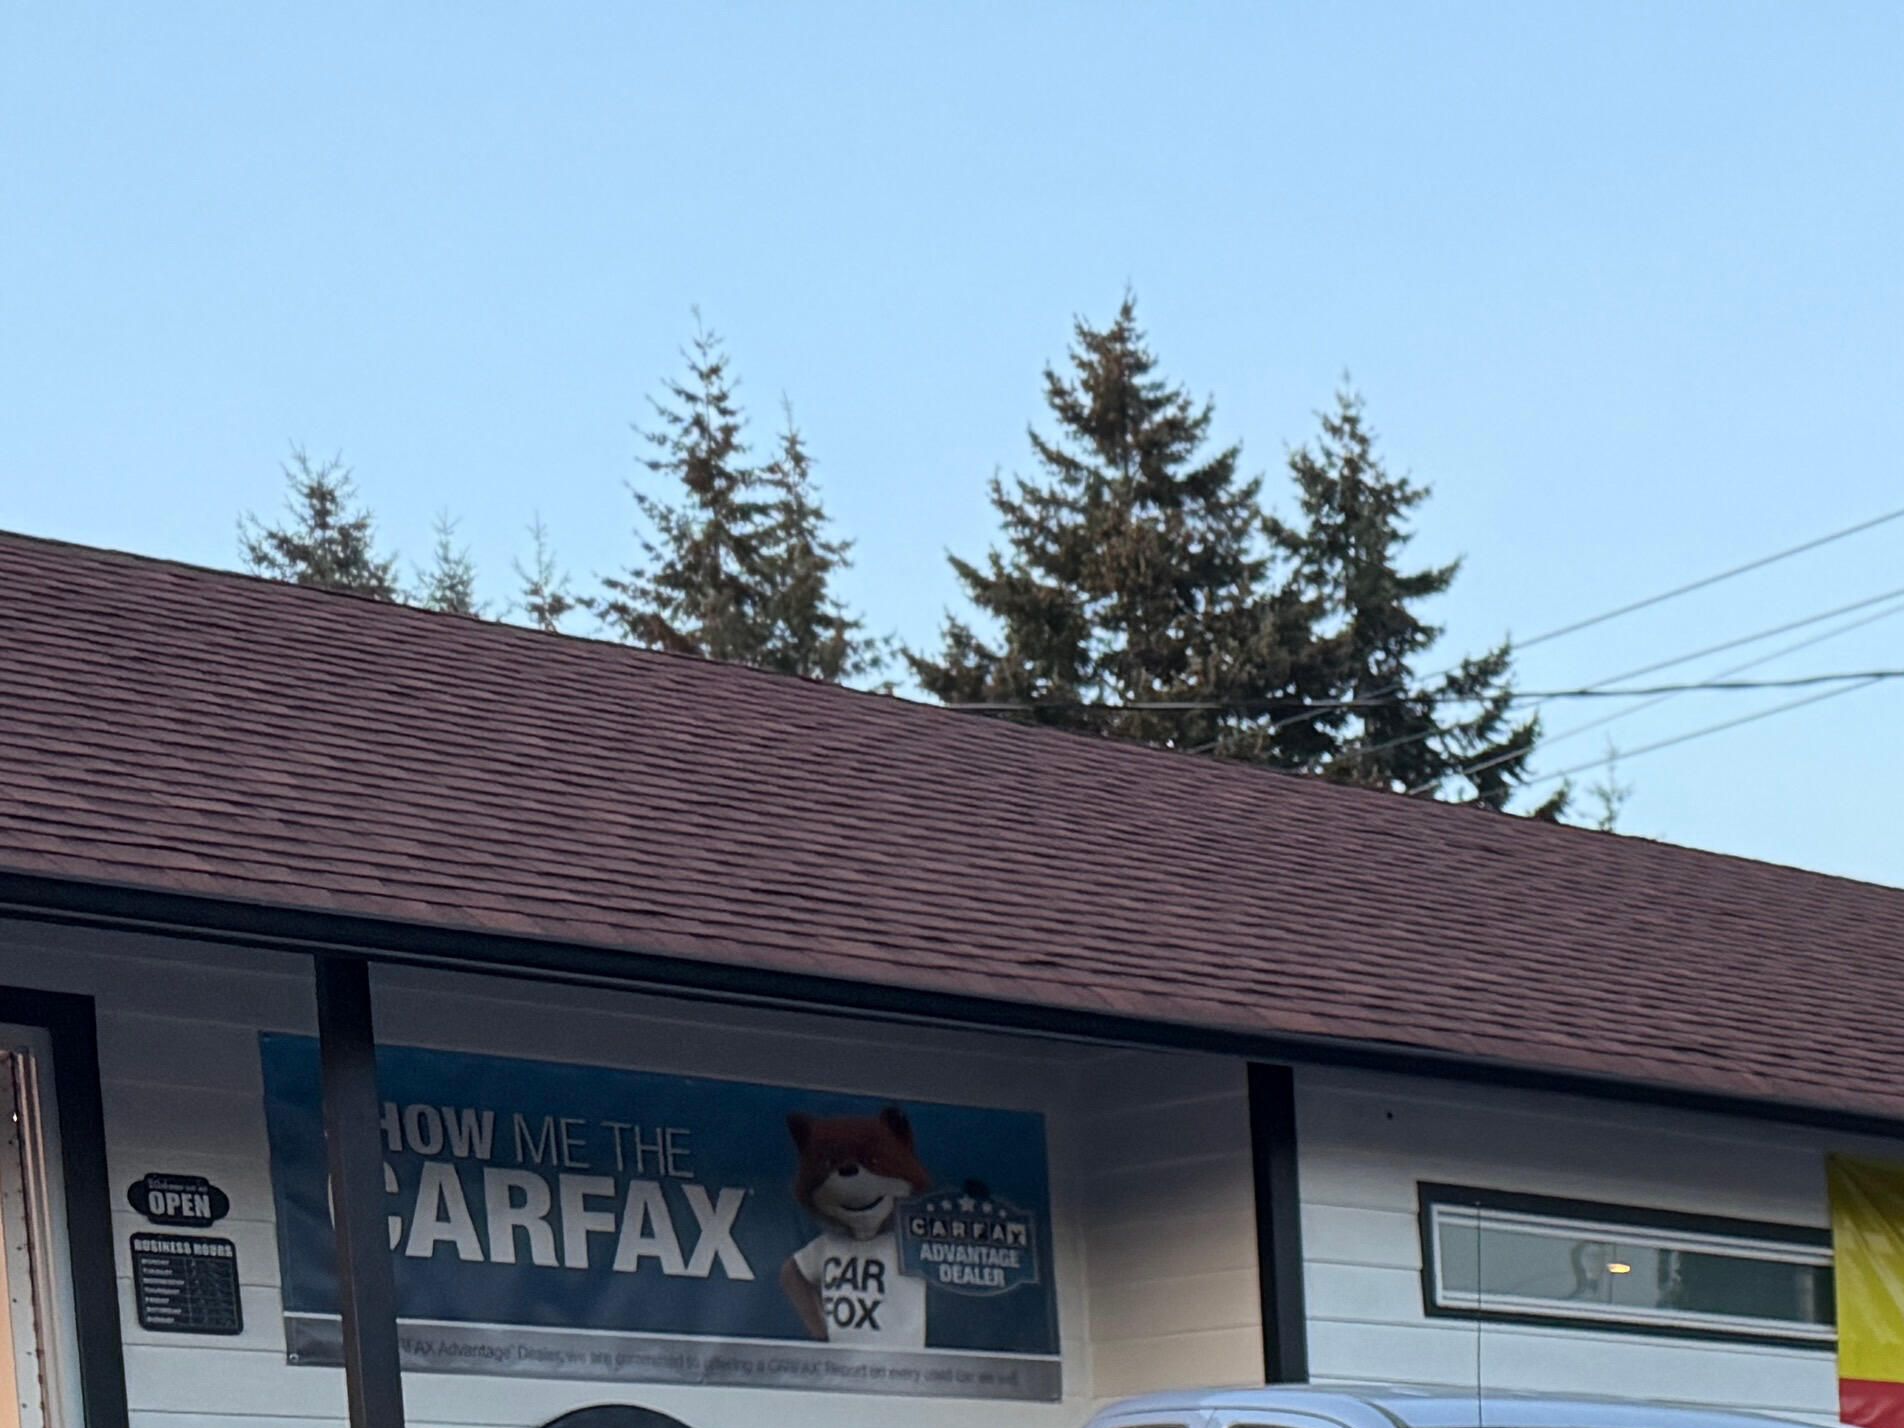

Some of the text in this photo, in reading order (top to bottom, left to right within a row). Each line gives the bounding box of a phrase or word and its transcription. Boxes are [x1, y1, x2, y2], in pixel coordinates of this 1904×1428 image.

[513, 1112, 590, 1169] ME
[601, 1120, 694, 1179] THE
[148, 1190, 212, 1218] OPEN
[911, 1217, 1026, 1245] CARFAX
[134, 1239, 232, 1258] BUSINESS HOURS
[920, 1242, 1020, 1269] ADVANTAGE
[824, 1256, 886, 1294] CAR
[939, 1264, 1005, 1287] DEALER
